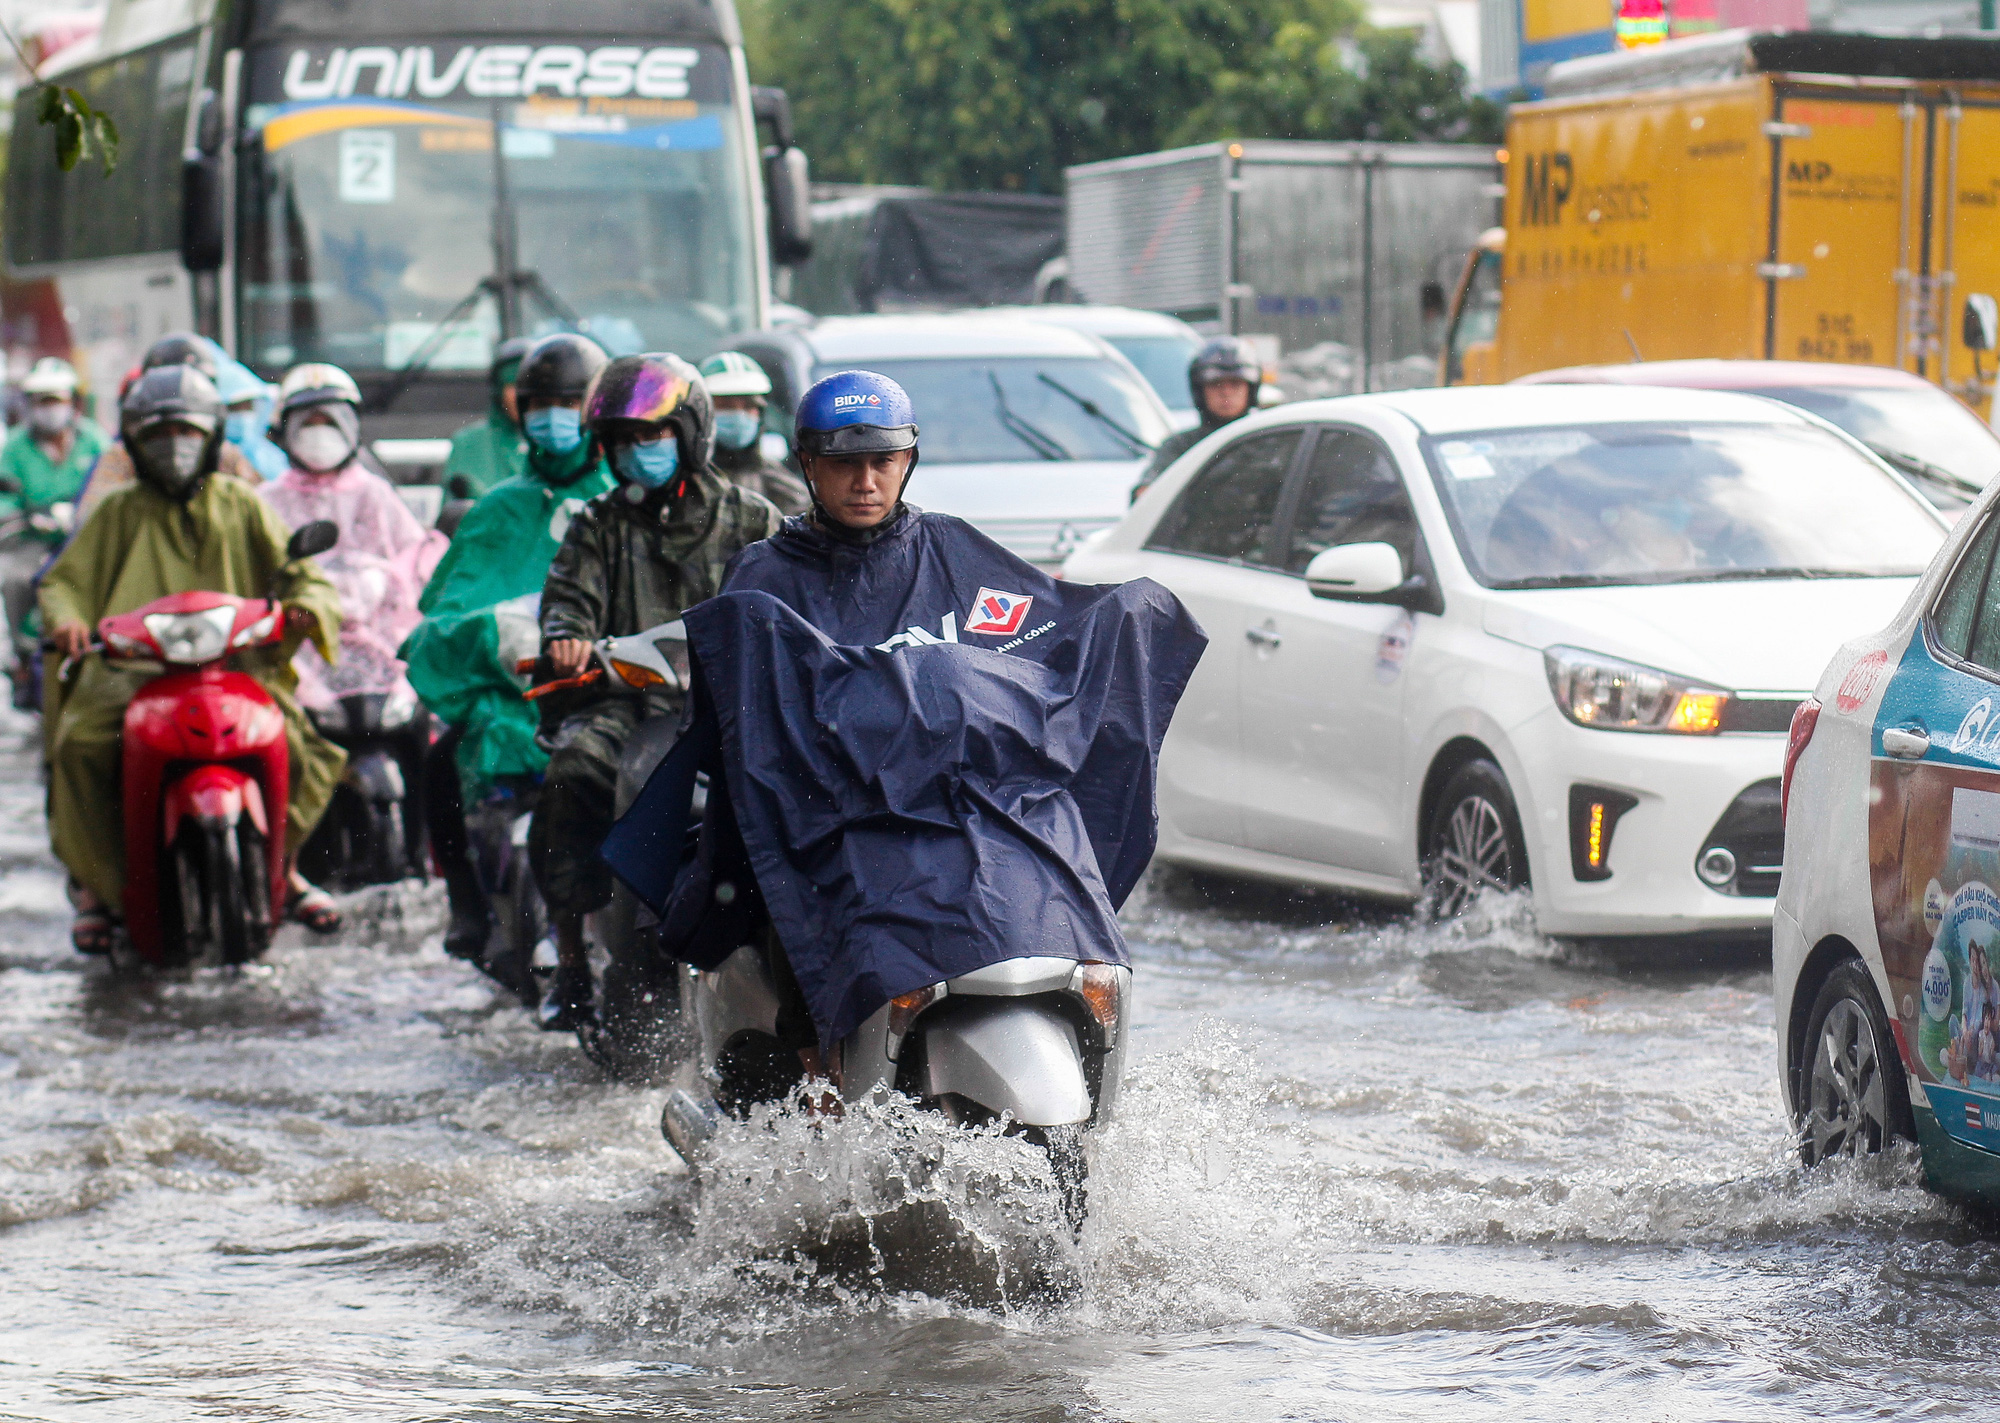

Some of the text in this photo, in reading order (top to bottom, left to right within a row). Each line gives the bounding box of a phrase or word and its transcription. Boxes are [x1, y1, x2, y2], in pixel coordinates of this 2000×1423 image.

[283, 45, 699, 98] UNIVERSE
[1786, 160, 1833, 183] MP
[1519, 152, 1575, 228] MP
[834, 394, 867, 407] BIDV
[1024, 619, 1057, 642] CÔNG
